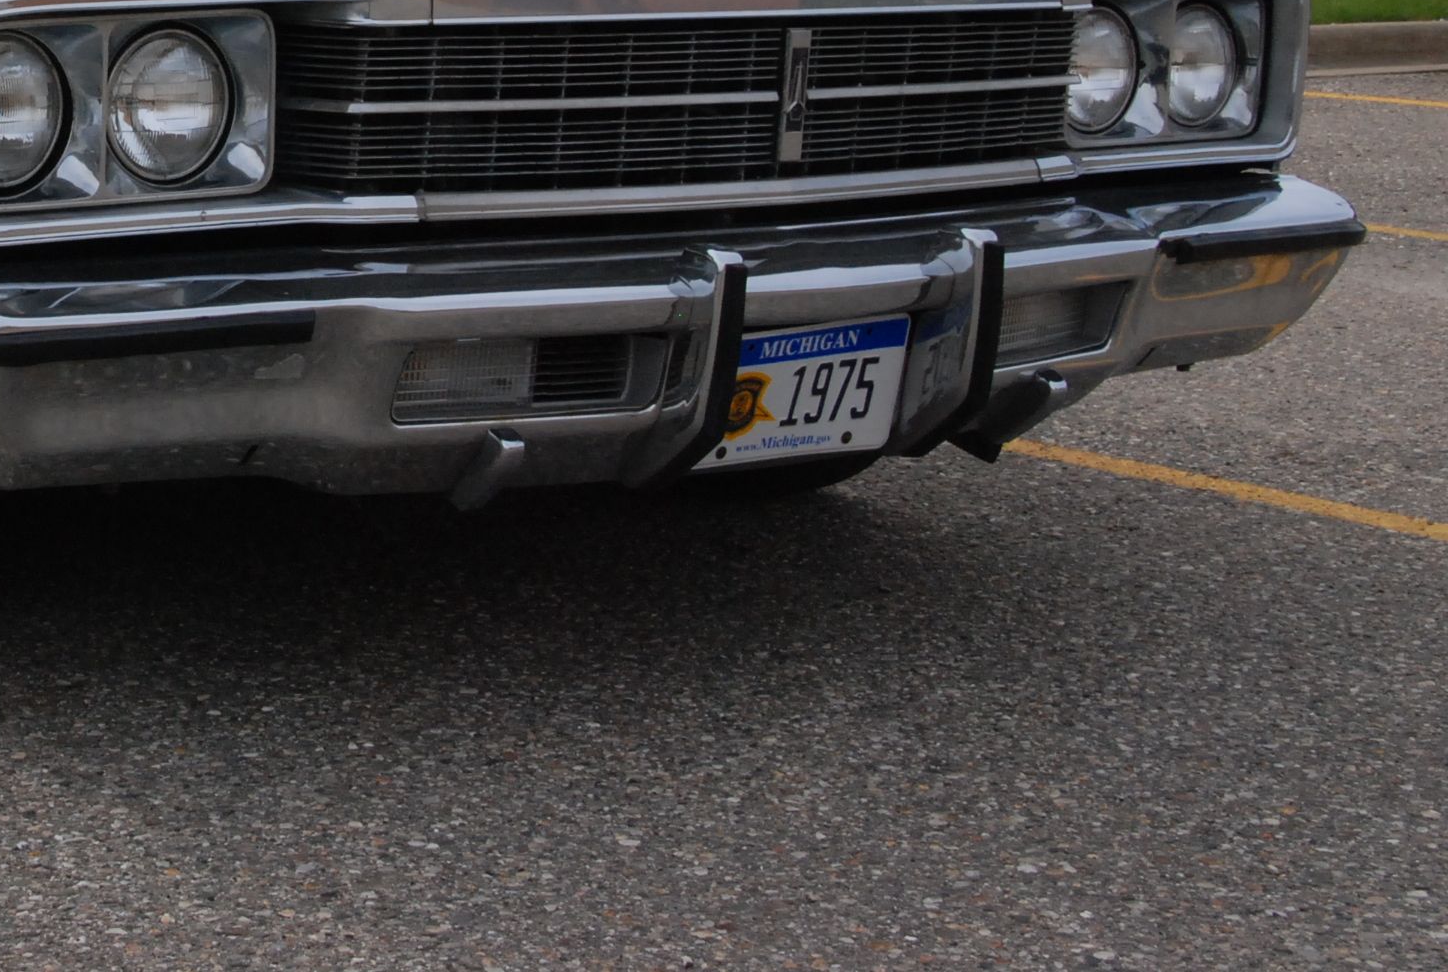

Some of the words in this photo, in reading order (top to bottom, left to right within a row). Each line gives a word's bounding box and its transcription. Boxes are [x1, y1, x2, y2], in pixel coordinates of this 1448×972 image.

[758, 329, 861, 360] MICHIGAN
[778, 356, 881, 428] 1975
[735, 434, 833, 453] www.Michigan.gov
